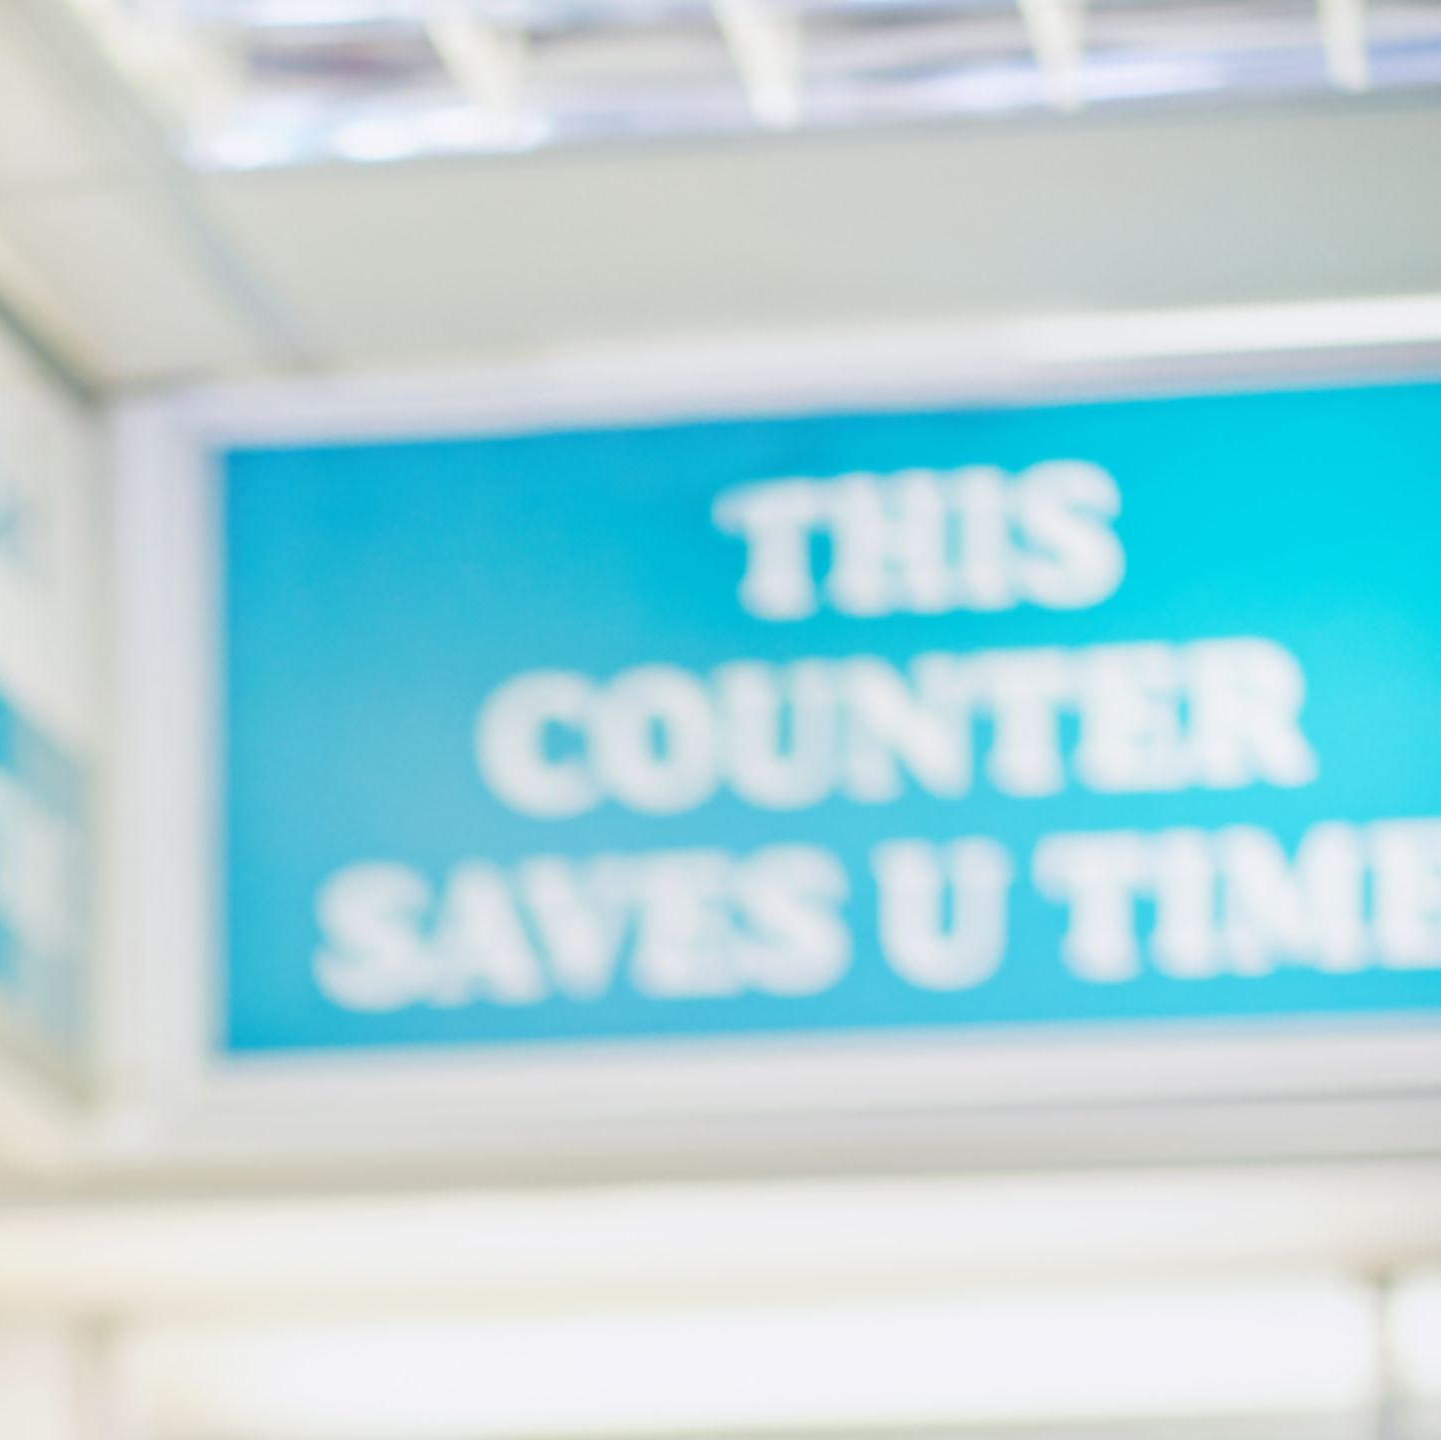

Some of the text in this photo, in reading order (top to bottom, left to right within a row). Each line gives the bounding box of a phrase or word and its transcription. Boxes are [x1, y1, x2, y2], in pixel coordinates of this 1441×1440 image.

[716, 461, 1123, 619] THIS
[474, 637, 1319, 820] COUNTER
[315, 817, 1441, 1010] SAVES U TIME
